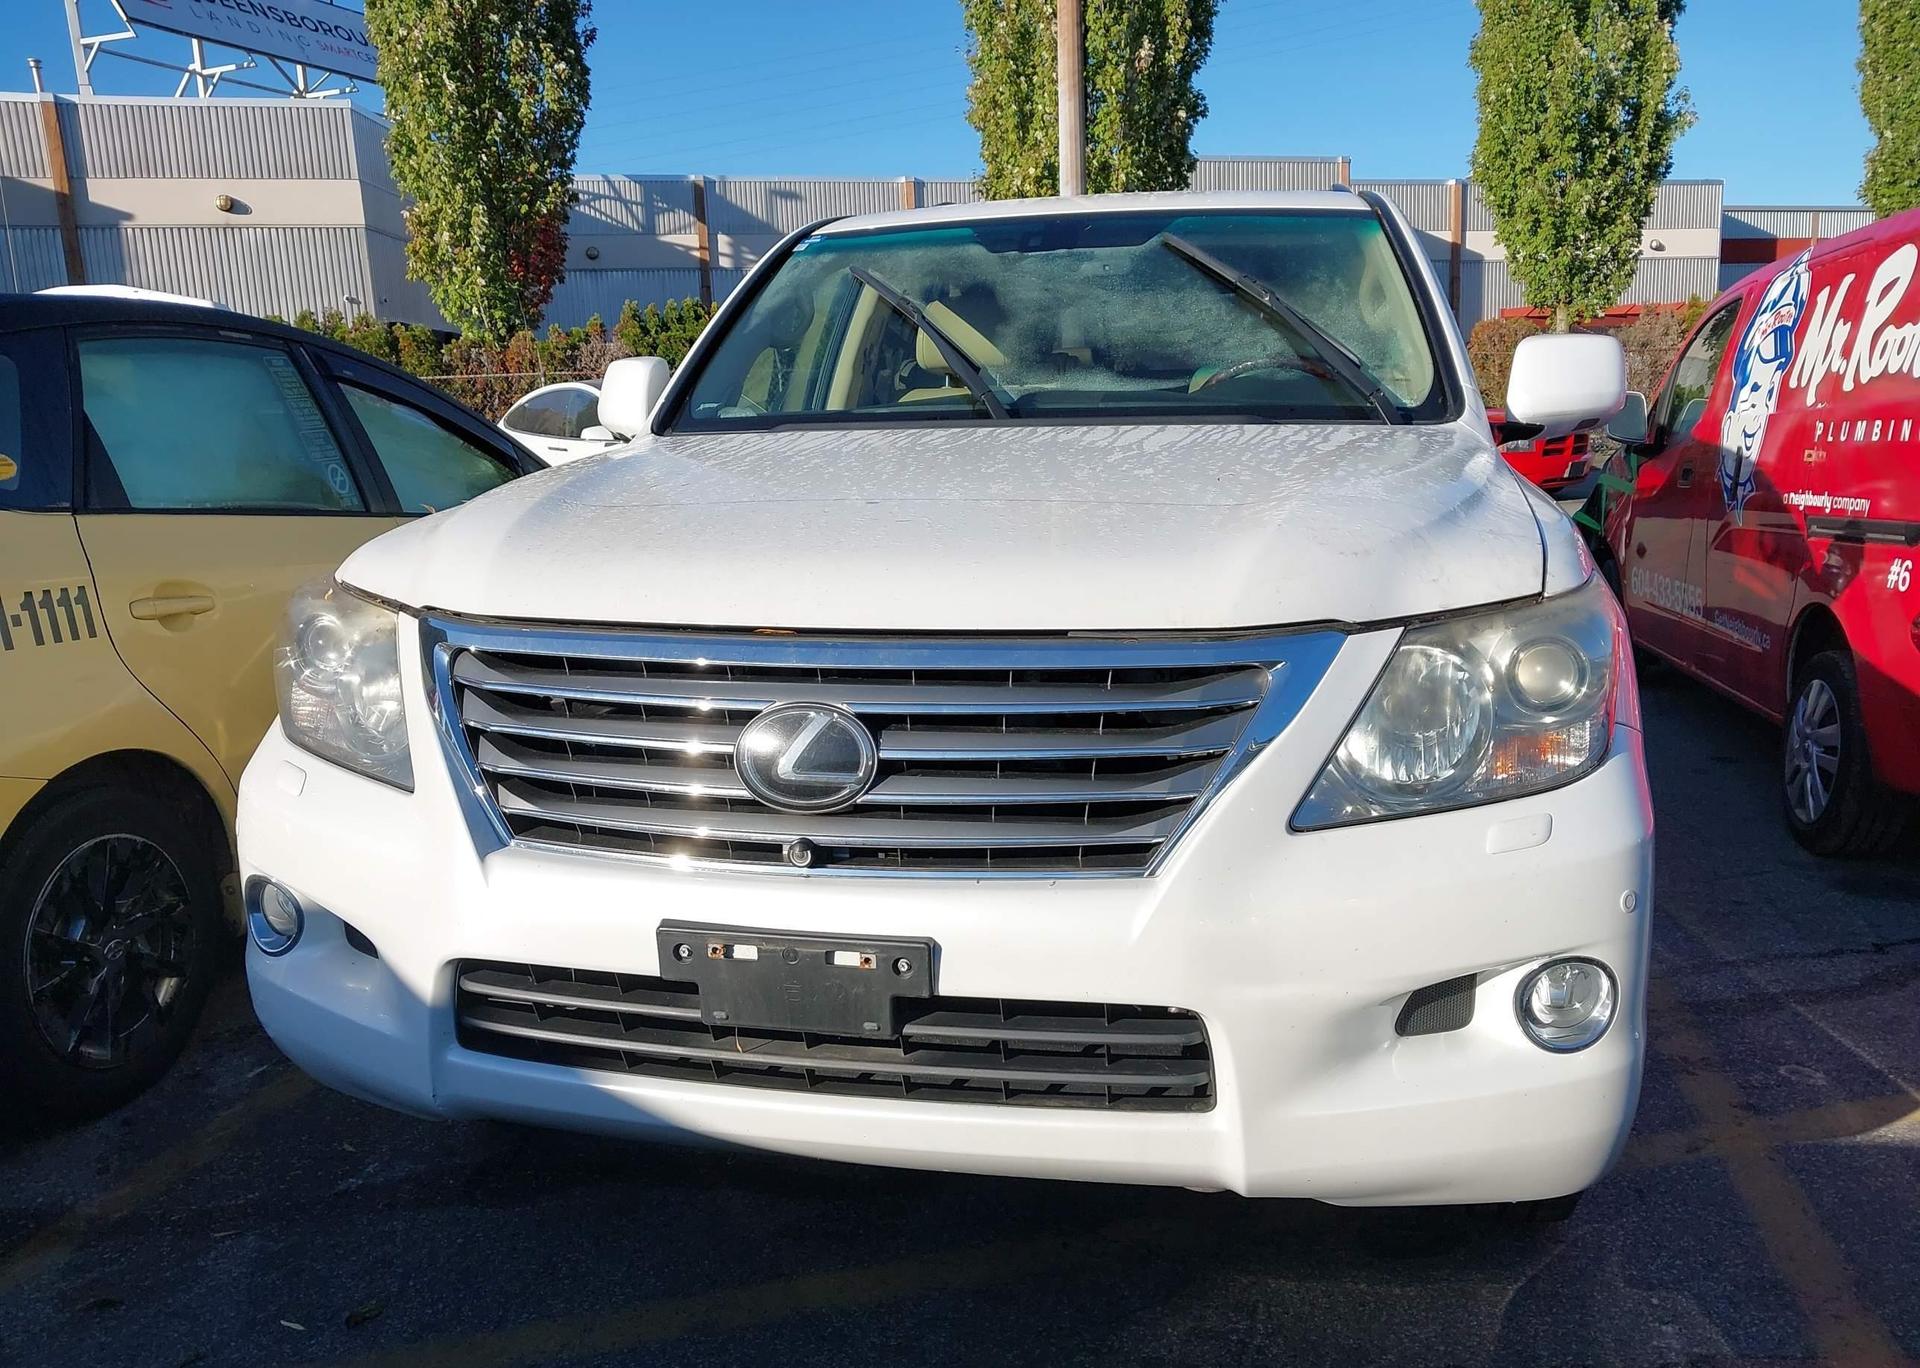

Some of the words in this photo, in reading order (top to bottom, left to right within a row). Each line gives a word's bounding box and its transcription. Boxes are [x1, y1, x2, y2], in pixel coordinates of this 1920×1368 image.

[188, 4, 311, 47] LANDING
[193, 0, 379, 49] EENSBOROU
[1789, 272, 1852, 408] Mr.
[1814, 418, 1920, 442] PLUMBIN
[1782, 492, 1790, 505] a
[1789, 489, 1833, 514] neighbourly
[1832, 496, 1871, 518] company
[1886, 557, 1913, 593] #6
